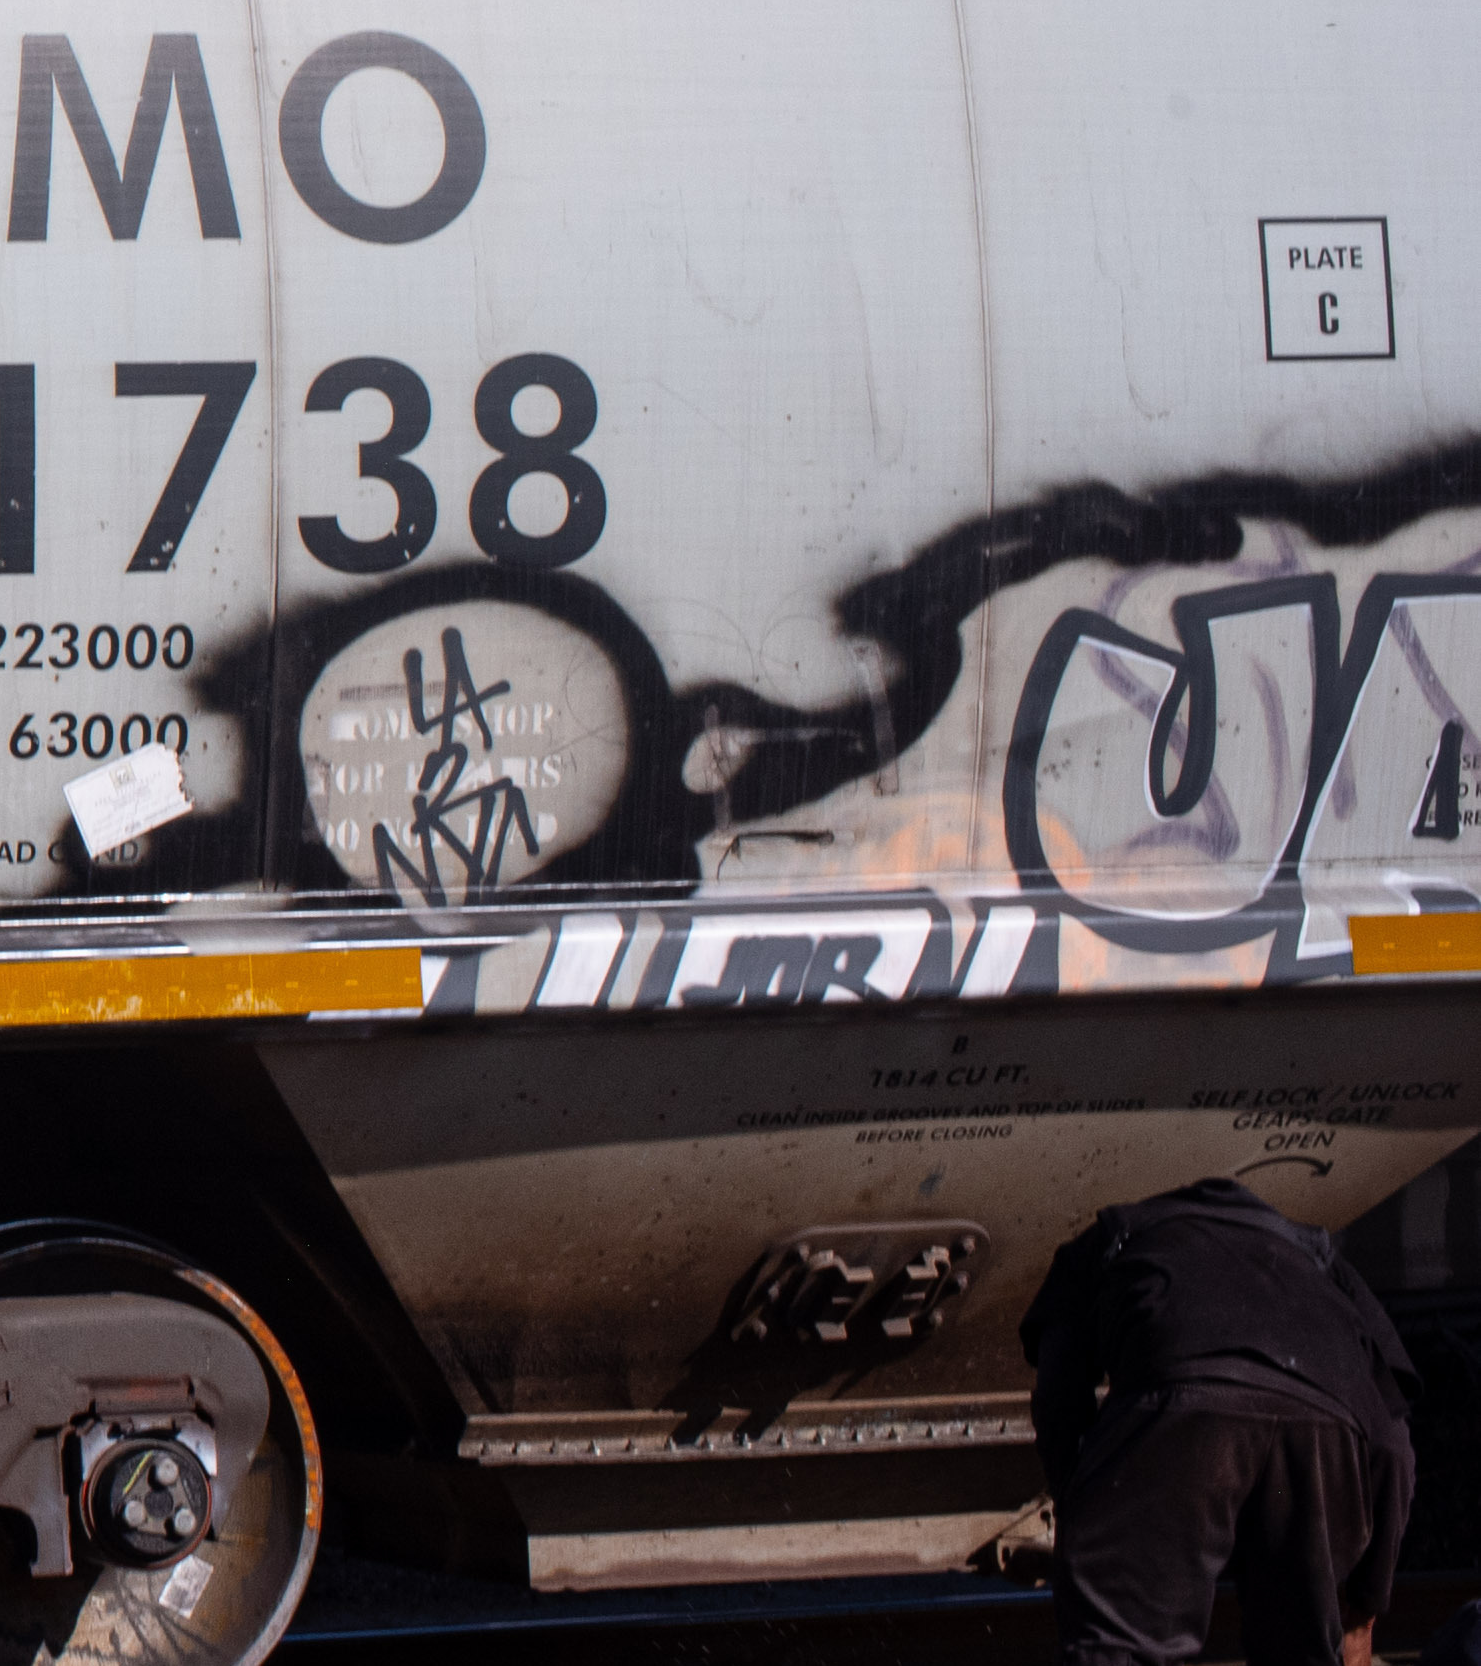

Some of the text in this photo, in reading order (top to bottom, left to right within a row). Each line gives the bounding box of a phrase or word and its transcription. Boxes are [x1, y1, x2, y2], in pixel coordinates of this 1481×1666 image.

[1288, 245, 1363, 271] PLATE
[1319, 292, 1339, 335] C
[9, 711, 190, 761] 63000
[946, 1067, 987, 1086] CU
[1254, 1086, 1320, 1106] LOCK
[1349, 1082, 1461, 1102] UNLOCK
[855, 1124, 1013, 1144] BEFORE CLOSING
[1264, 1130, 1336, 1151] OPEN
